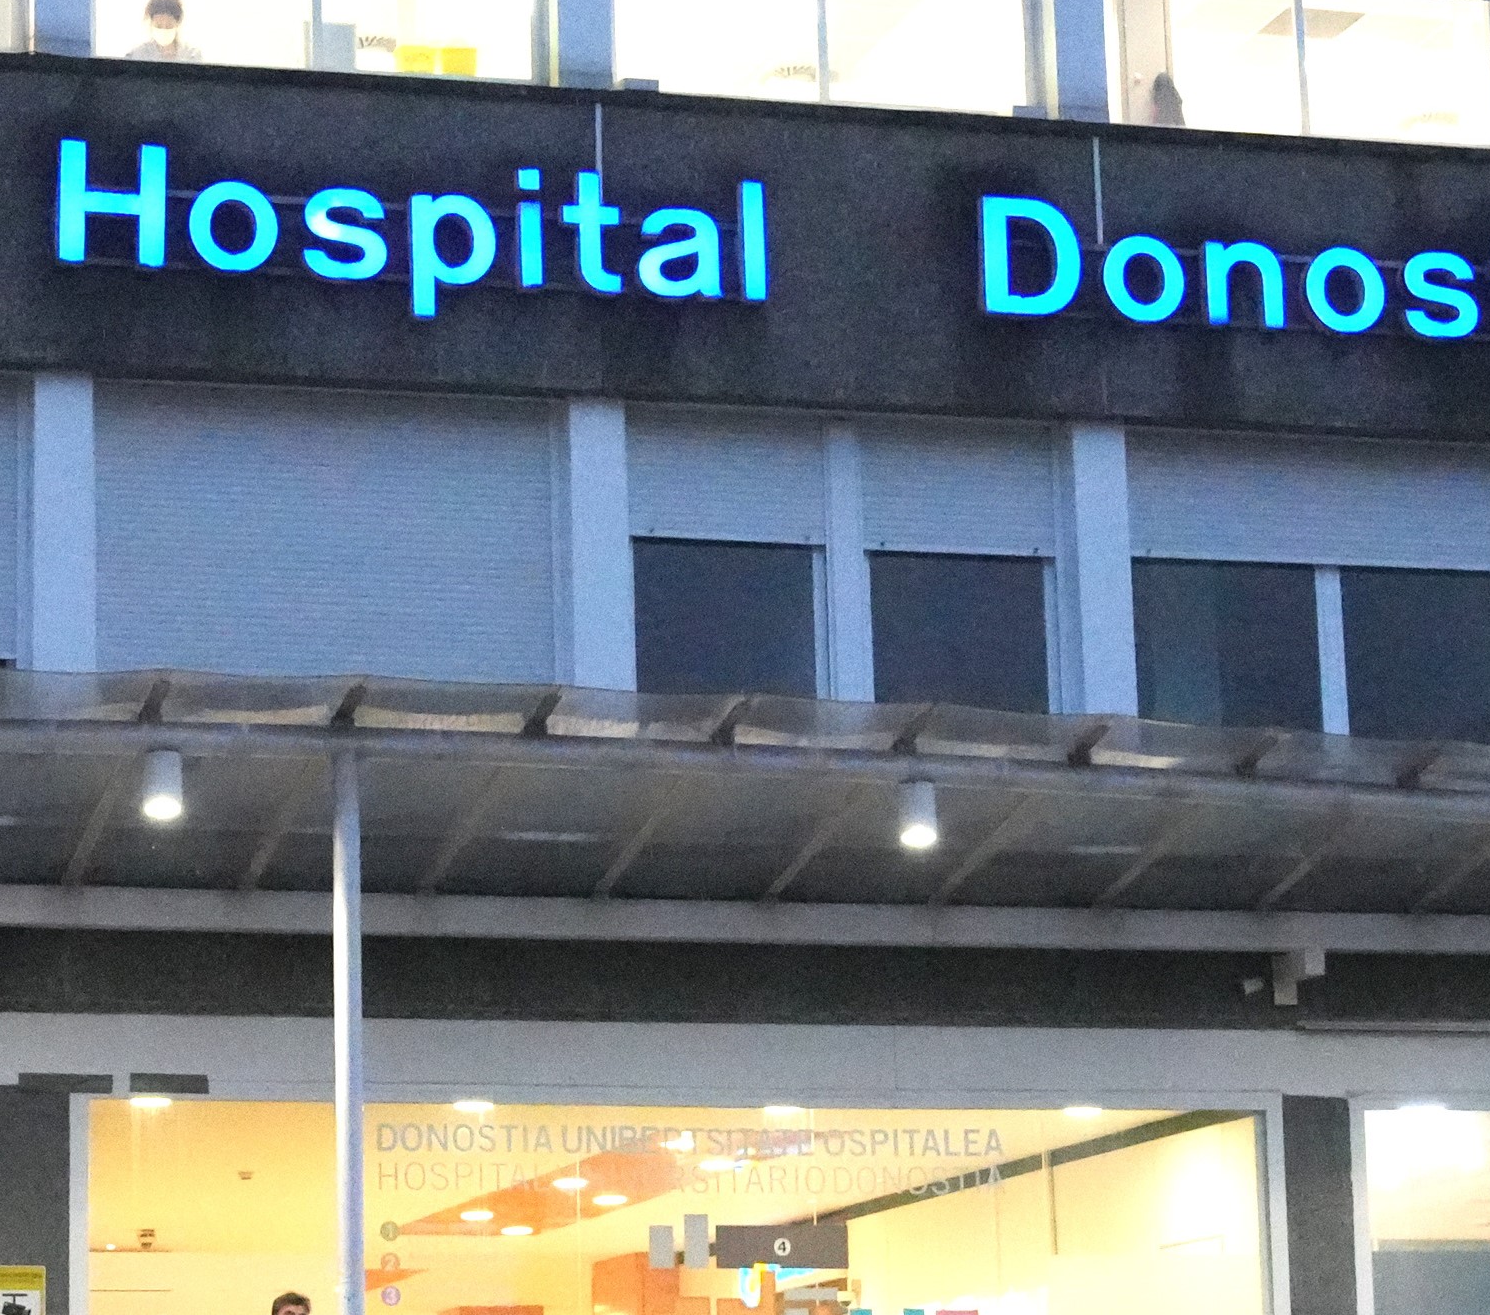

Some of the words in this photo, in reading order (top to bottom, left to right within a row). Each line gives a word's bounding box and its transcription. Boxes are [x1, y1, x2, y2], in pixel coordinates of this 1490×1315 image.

[57, 139, 769, 318] Hospital
[375, 1122, 554, 1154] DONOSTIA
[823, 1127, 1004, 1157] OSPITALEA
[778, 1241, 786, 1252] 4
